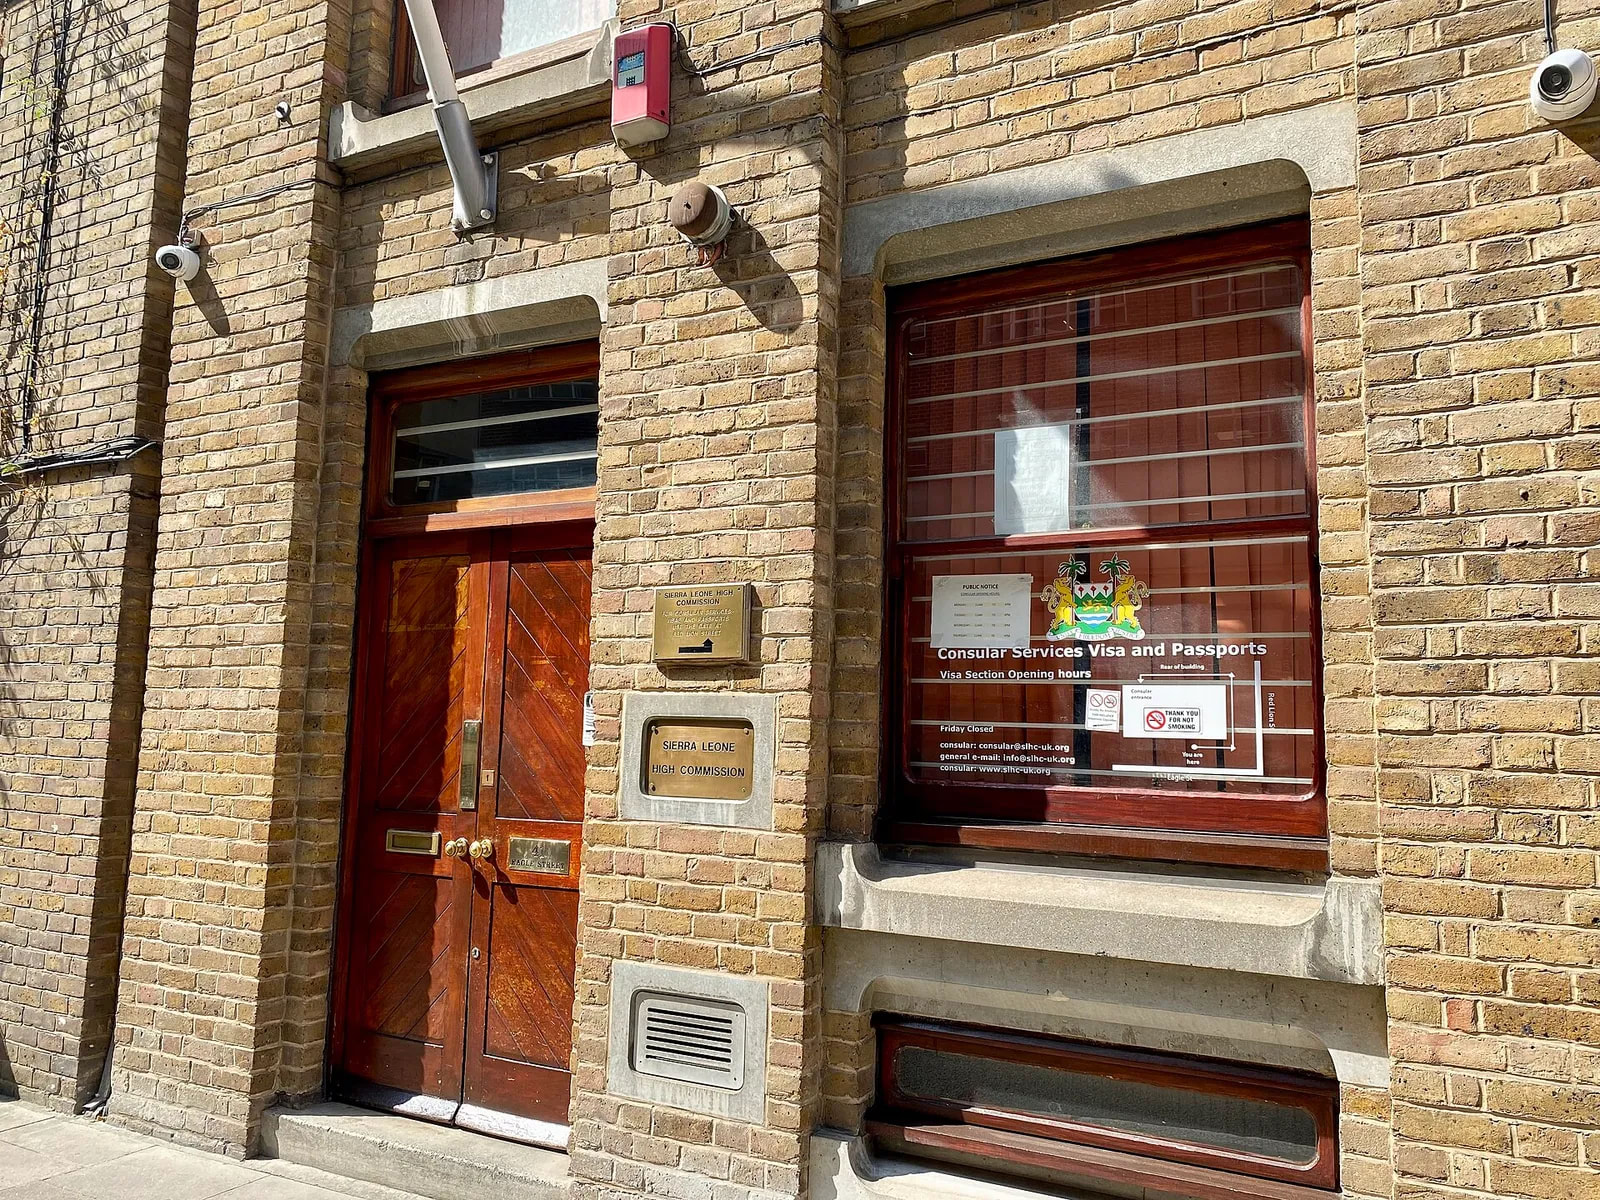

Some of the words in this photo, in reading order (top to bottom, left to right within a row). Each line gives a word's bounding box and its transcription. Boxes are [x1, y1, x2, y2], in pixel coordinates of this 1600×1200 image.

[690, 590, 713, 598] LEONE
[716, 589, 734, 597] HIGH
[676, 598, 720, 607] COMMISSION
[937, 646, 1007, 660] Consular
[1012, 644, 1083, 658] Services
[1088, 644, 1126, 657] Visa
[1131, 642, 1165, 657] and
[1172, 641, 1267, 658] Passports
[940, 670, 962, 679] Visa
[965, 670, 1005, 679] Section
[1008, 669, 1054, 680] Opening
[1058, 668, 1092, 678] hours
[940, 725, 965, 733] Friday
[967, 725, 994, 733] Closed
[663, 740, 697, 751] SIERRA
[702, 742, 735, 752] LEONE
[940, 741, 977, 750] consular:
[978, 743, 1070, 752] consular@slhc-uk.org
[940, 752, 970, 761] general
[972, 753, 1001, 761] e-mail:
[1003, 754, 1076, 764] info@slhc-uk.org
[652, 764, 675, 774] HIGH
[680, 765, 745, 777] COMMISSION
[940, 764, 977, 773] consular:
[979, 765, 1051, 775] www.slhc-uk.org
[511, 859, 535, 867] EAGLE
[537, 861, 565, 869] STREET
